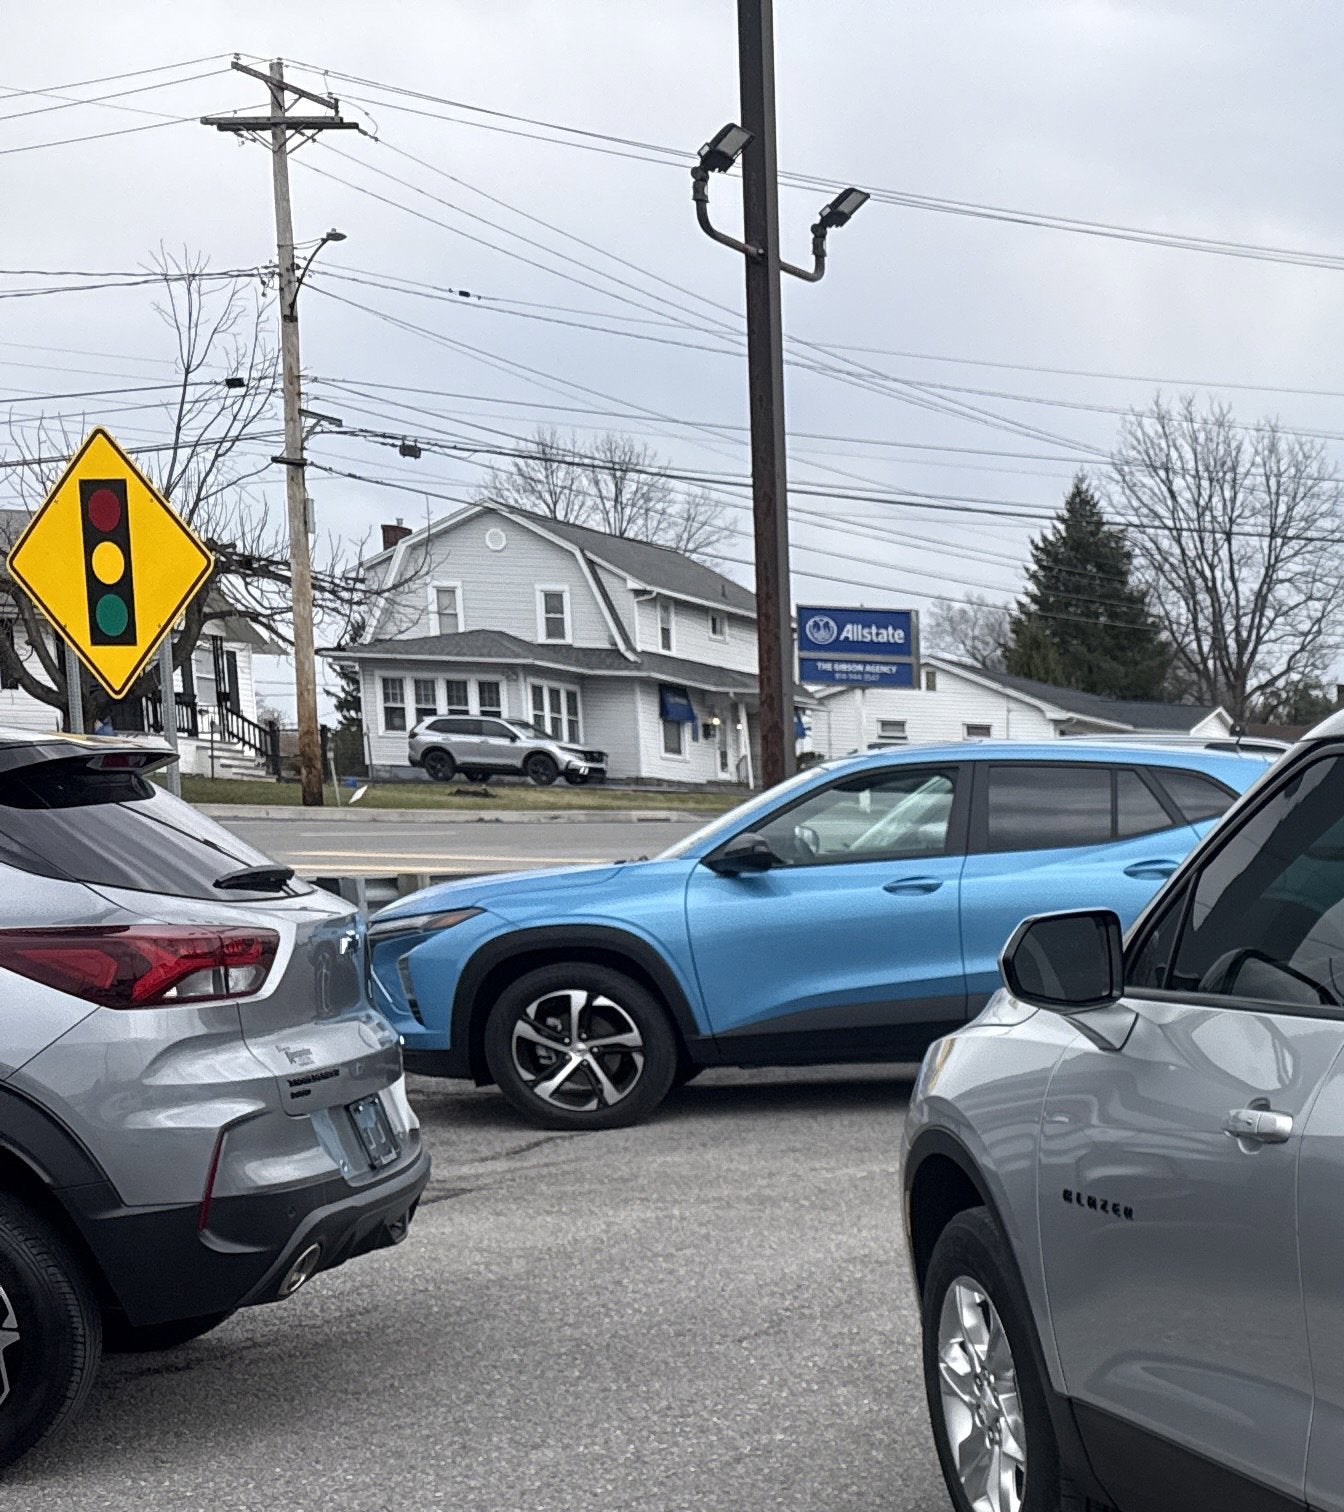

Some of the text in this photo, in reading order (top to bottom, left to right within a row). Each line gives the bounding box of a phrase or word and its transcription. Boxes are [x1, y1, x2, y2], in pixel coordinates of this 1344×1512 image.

[839, 623, 905, 644] Allstate
[816, 661, 833, 672] THE
[865, 663, 897, 675] AGENCY
[1062, 1188, 1134, 1221] BLAZER
